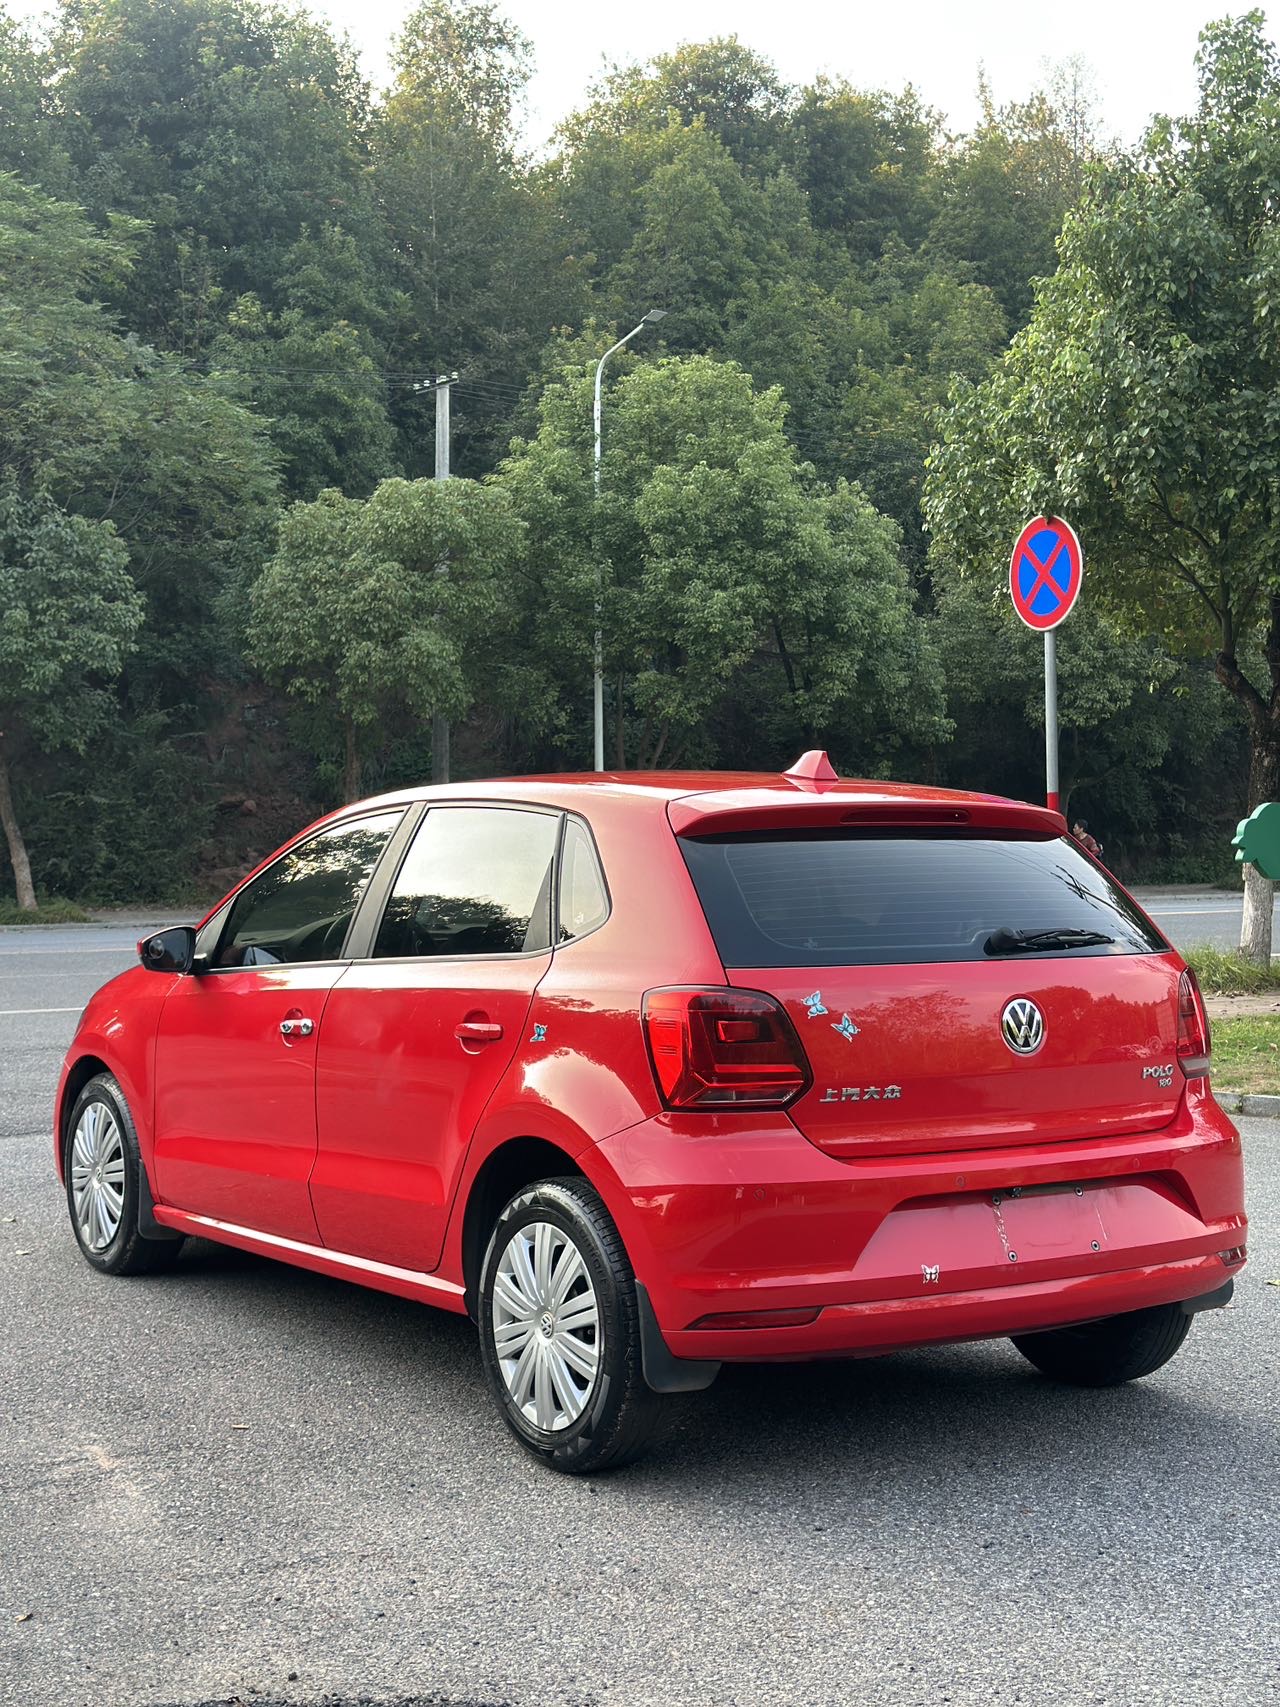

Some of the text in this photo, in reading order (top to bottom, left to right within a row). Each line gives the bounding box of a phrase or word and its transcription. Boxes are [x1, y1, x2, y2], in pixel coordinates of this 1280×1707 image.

[1143, 1064, 1174, 1079] POLO
[1159, 1077, 1173, 1088] 180
[819, 1085, 902, 1103] 上汽大众
